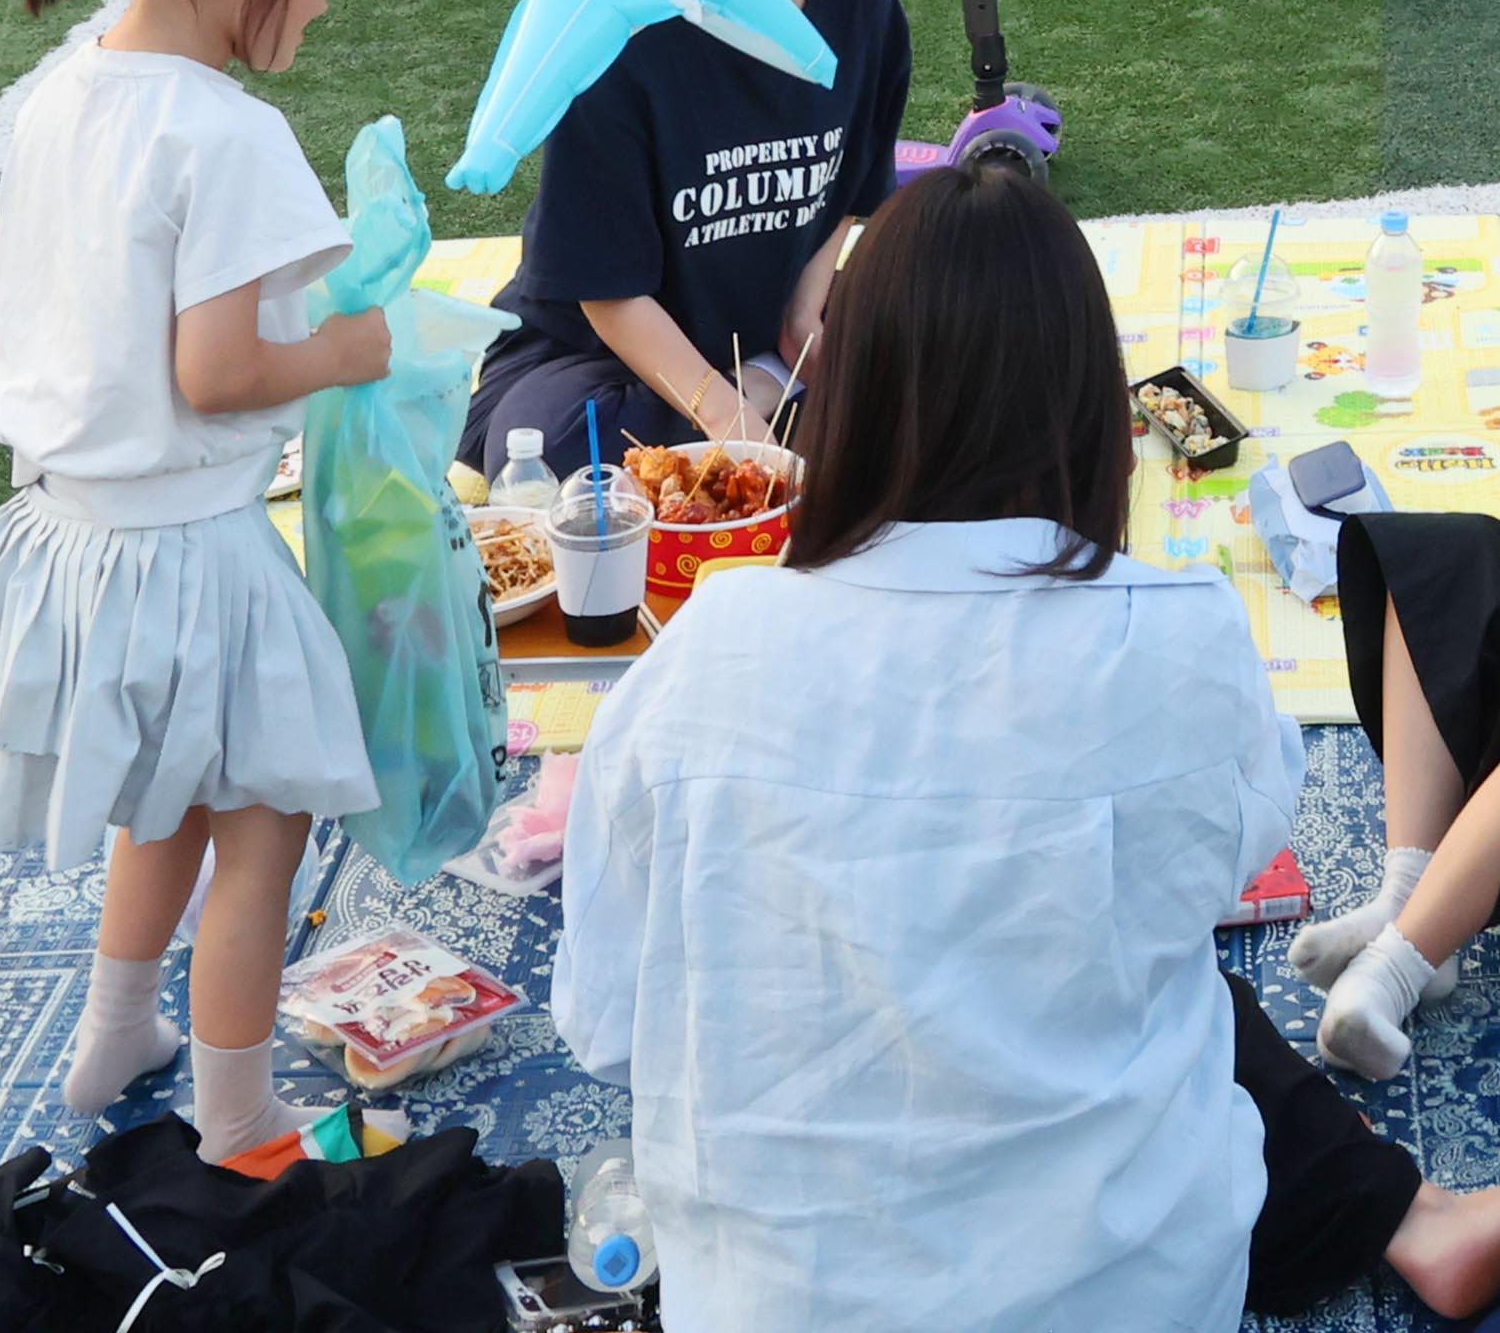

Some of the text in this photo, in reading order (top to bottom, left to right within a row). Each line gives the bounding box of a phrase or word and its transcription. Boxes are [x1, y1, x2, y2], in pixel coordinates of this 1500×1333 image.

[705, 127, 844, 176] PROPERTY OF
[684, 209, 790, 248] ATHLETIC
